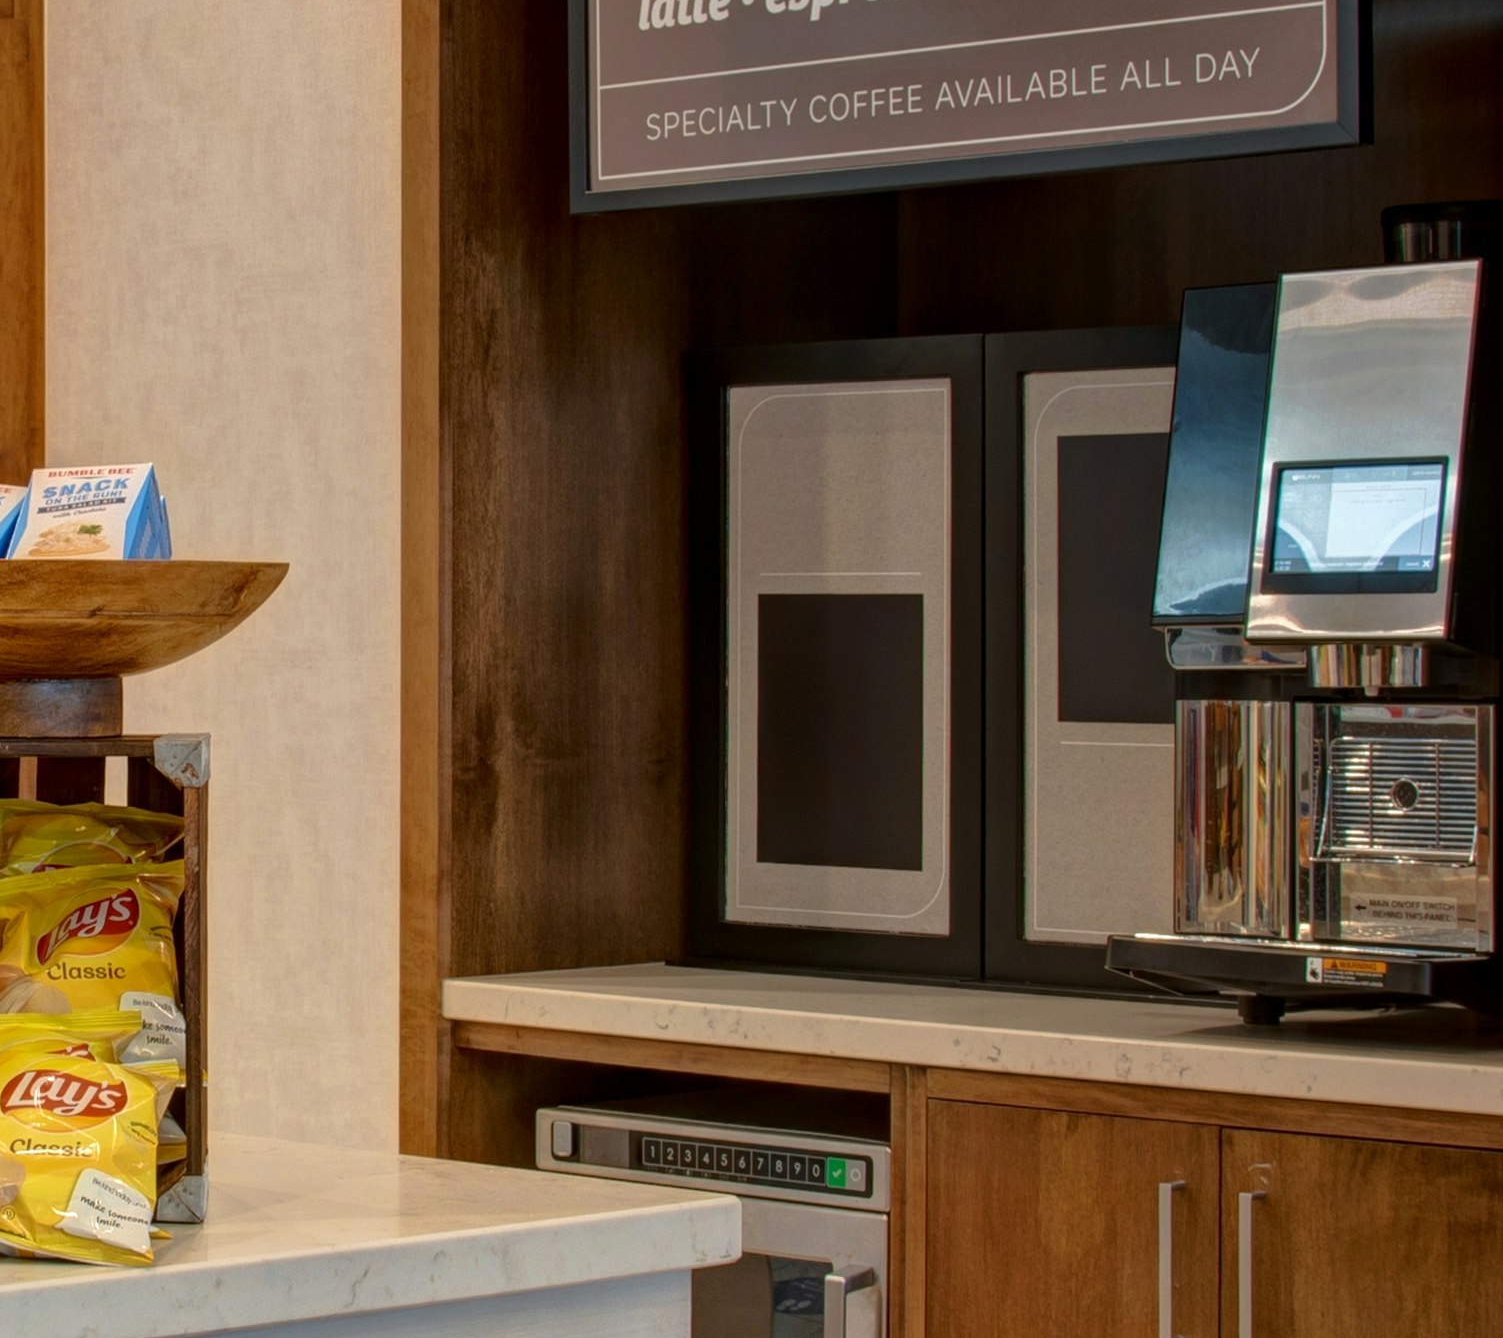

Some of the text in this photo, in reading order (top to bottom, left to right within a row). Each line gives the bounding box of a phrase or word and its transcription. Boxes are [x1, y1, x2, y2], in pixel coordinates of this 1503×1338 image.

[645, 48, 1260, 142] SPECIALTY COFFEE AVAILABLE ALL DAY
[48, 467, 135, 478] BUMBLE BEE
[43, 478, 130, 498] SNACK
[45, 497, 63, 505] ON
[66, 494, 90, 503] THE
[1369, 899, 1454, 911] MAIN ON/OFF SWITCH
[46, 893, 131, 959] Lay's
[1372, 911, 1450, 922] BEHIND THIS PANEL
[47, 962, 126, 981] Classic
[1339, 962, 1377, 970] WARNING
[7, 1072, 122, 1116] Lay's
[10, 1138, 95, 1158] Classic
[650, 1146, 819, 1177] 1 2 3 4 5 6 7 8 9 0
[80, 1195, 106, 1214] make
